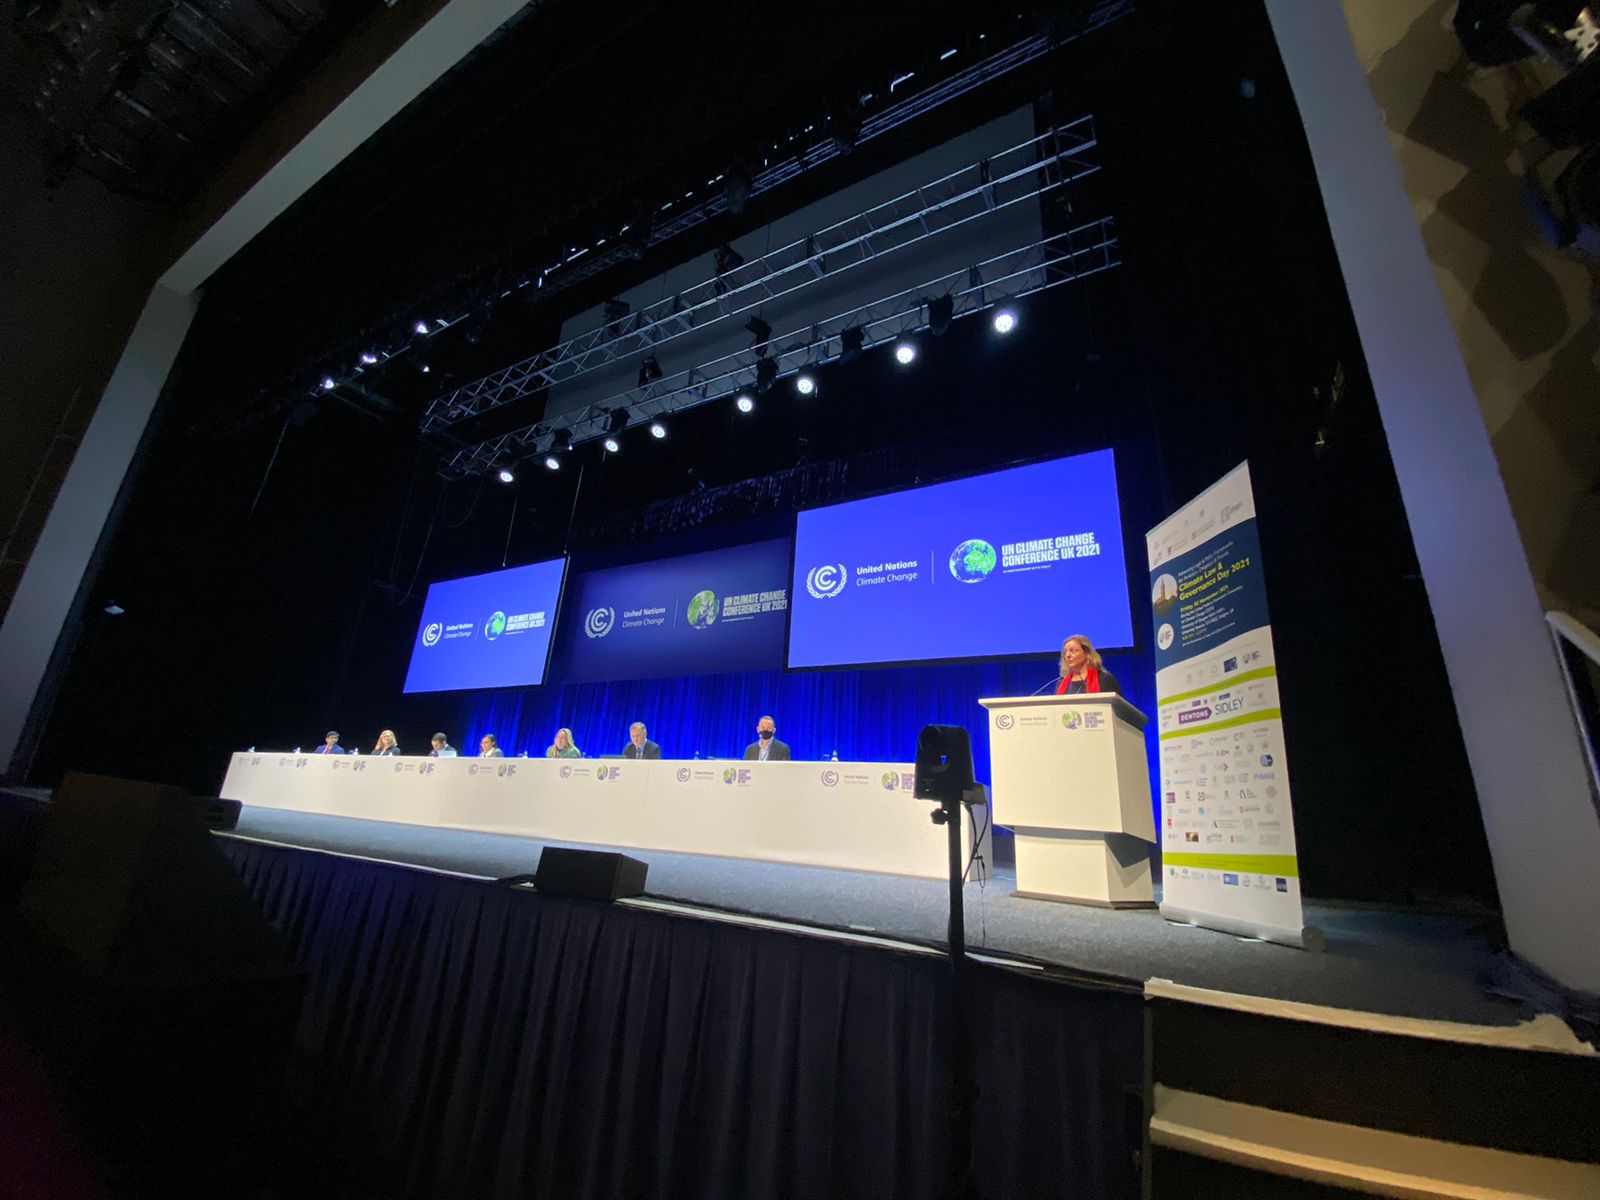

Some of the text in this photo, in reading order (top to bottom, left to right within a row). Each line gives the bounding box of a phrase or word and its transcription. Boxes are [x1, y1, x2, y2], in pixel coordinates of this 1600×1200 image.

[1001, 532, 1095, 556] UN CLIMATE CHANGE
[1002, 543, 1100, 567] CONFERENCE UK 2021
[856, 560, 918, 575] United Nations
[856, 572, 918, 587] Climate Change
[1179, 562, 1223, 592] Climate Law &
[1179, 577, 1217, 601] Governance
[1217, 570, 1230, 581] Day
[1231, 557, 1250, 573] 2021
[723, 589, 786, 607] UN CLIMATE CHANGE
[623, 607, 666, 618] United Nations
[722, 599, 788, 616] CONFERENCE UK 2021
[622, 618, 665, 628] Climate Change
[1181, 697, 1243, 722] DENTONS SIDLEY
